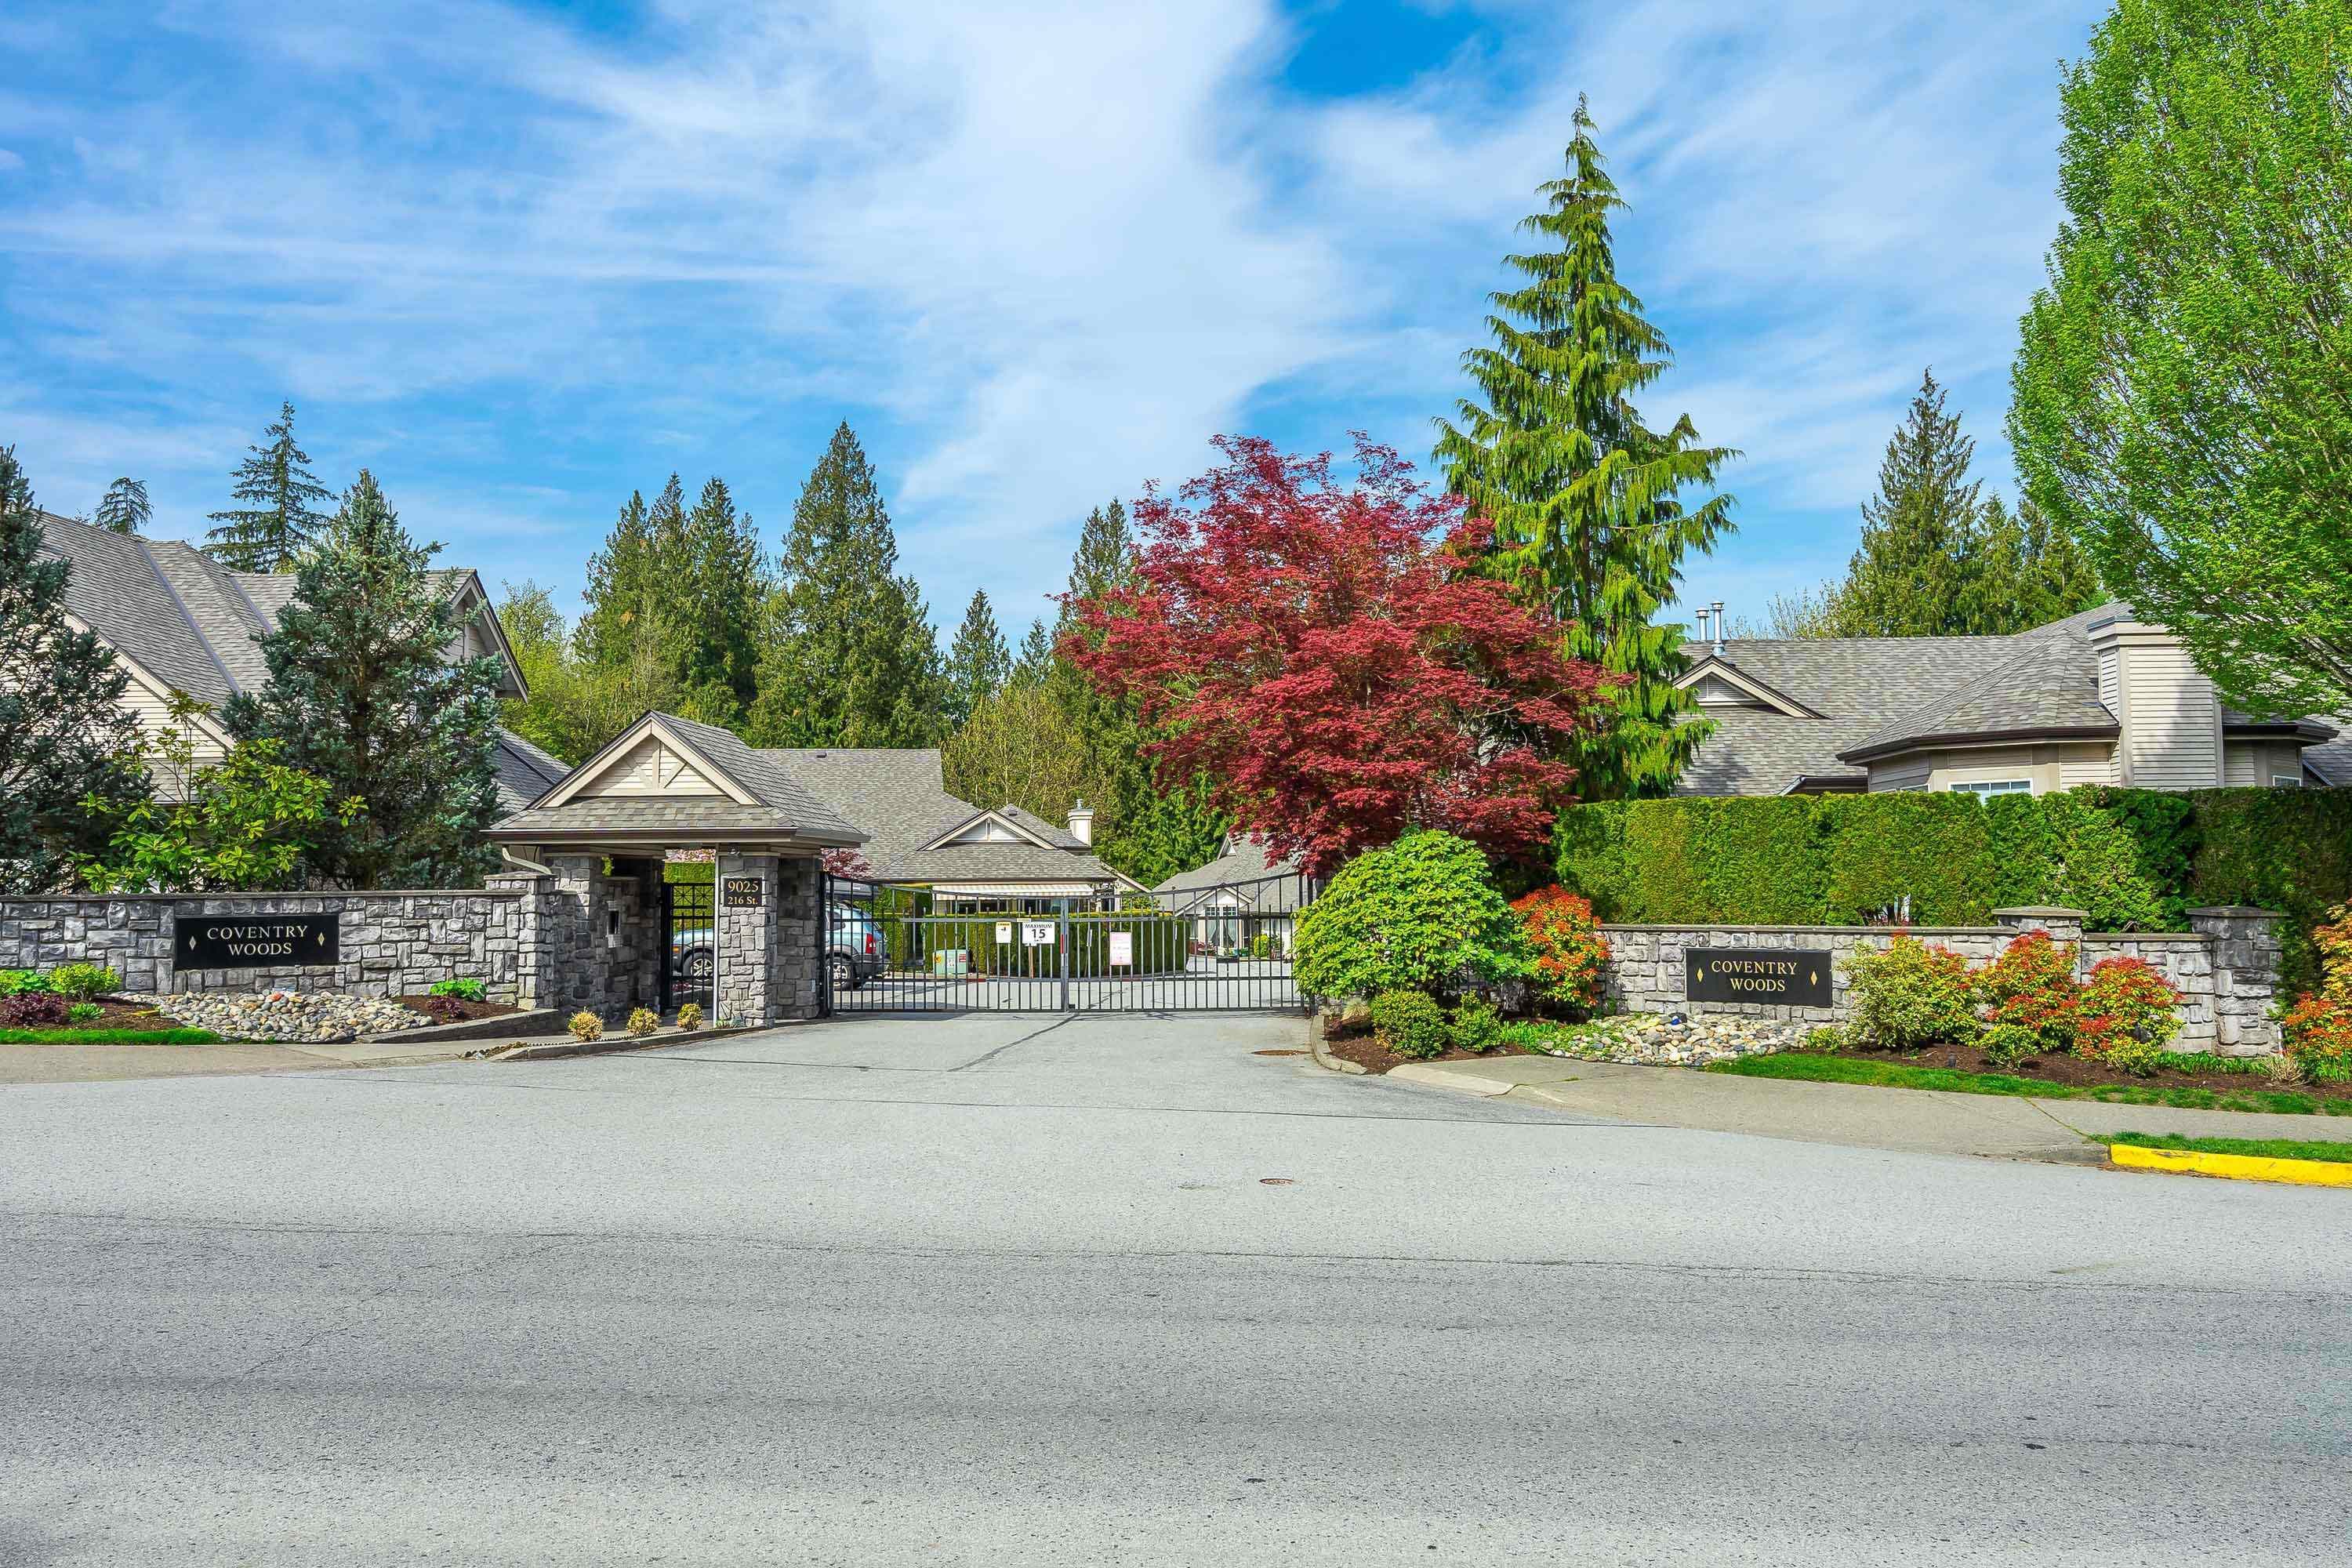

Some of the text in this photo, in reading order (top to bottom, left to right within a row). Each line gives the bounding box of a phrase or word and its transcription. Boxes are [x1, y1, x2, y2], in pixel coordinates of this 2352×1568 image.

[728, 880, 759, 893] 9025
[727, 896, 744, 905] 216
[206, 925, 308, 939] COVENTRY
[1031, 928, 1046, 938] 15
[228, 942, 292, 956] WOODS
[1711, 960, 1797, 975] COVENTRY
[1730, 978, 1786, 992] WOODS
